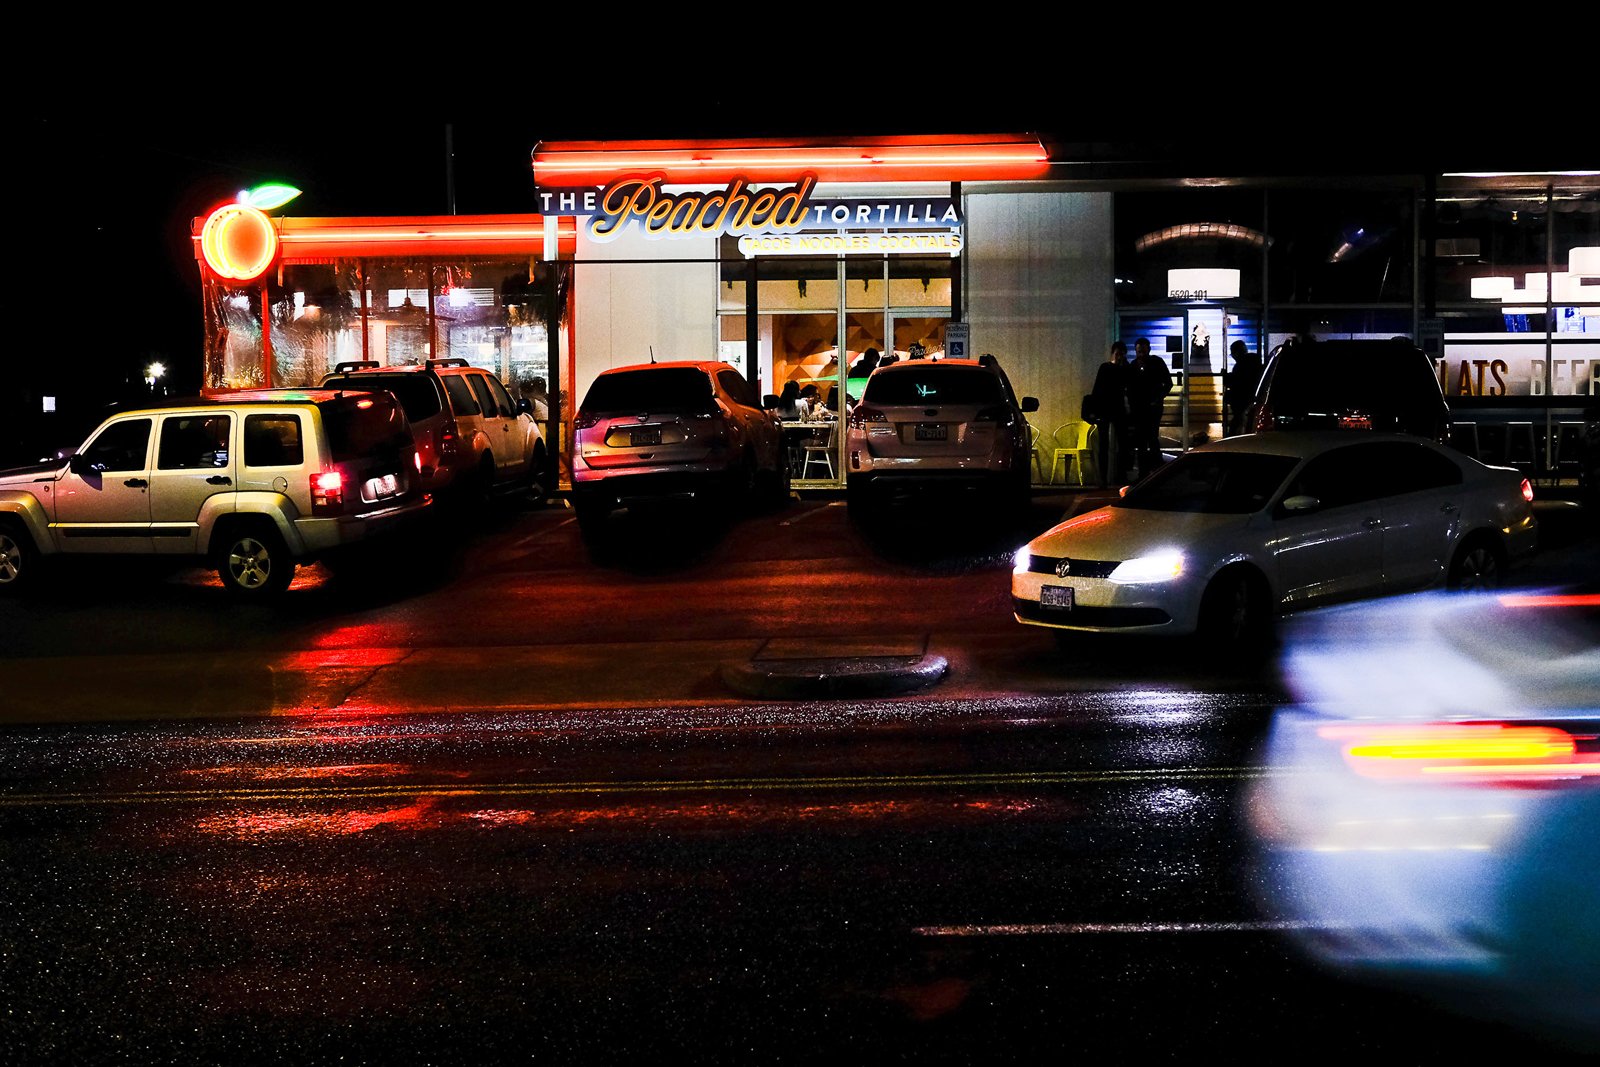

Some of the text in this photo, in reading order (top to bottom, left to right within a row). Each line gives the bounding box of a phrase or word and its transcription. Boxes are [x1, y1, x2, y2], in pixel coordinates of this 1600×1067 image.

[540, 175, 960, 237] THE Peached TORTILLA
[743, 235, 961, 251] TACOS NOODLES COCKTAILS
[1170, 290, 1207, 301] 5520-101
